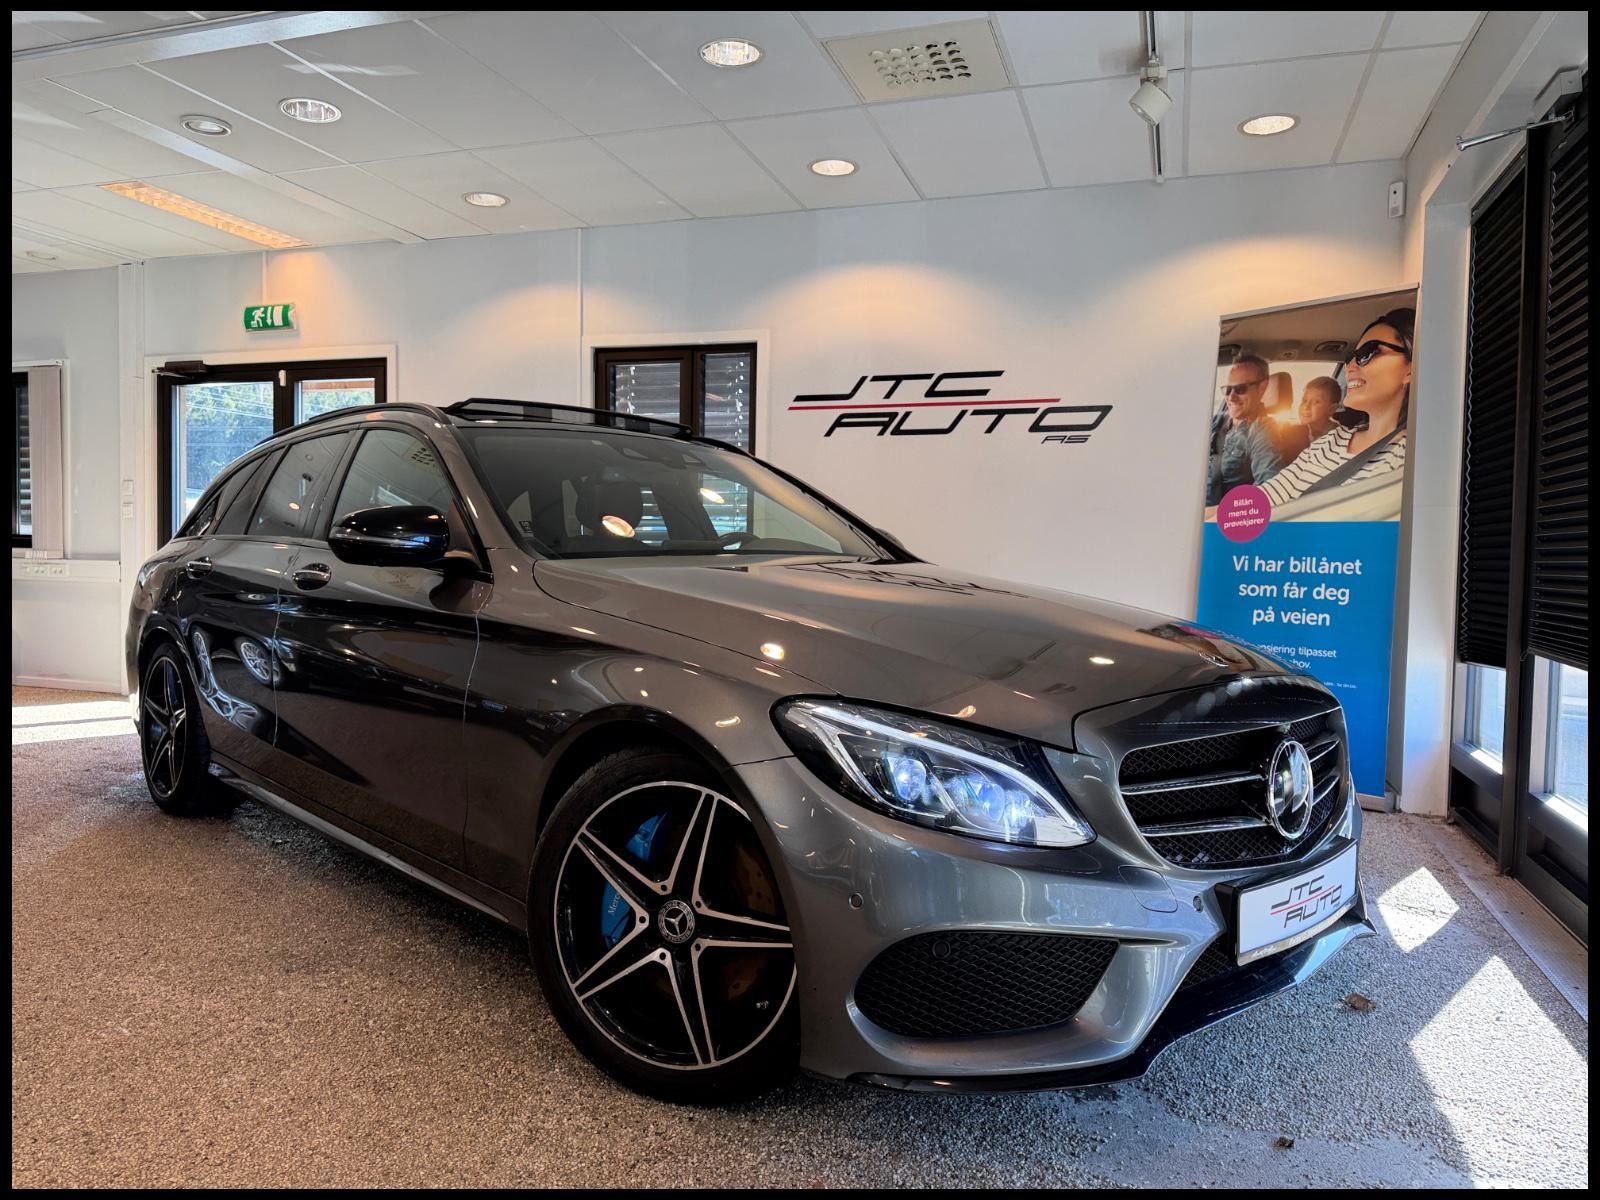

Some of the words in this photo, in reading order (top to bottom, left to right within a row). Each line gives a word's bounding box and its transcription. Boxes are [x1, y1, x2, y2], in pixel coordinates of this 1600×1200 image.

[793, 370, 1005, 402] JTC
[823, 405, 1113, 437] AUTO
[1041, 434, 1091, 444] AS
[1228, 510, 1247, 518] mens
[1249, 507, 1259, 515] du
[1233, 498, 1253, 507] Billån
[1223, 518, 1265, 530] prøvekjører
[1232, 555, 1248, 572] Vi
[1254, 556, 1284, 573] har
[1289, 556, 1362, 575] billånet
[1238, 582, 1277, 598] som
[1283, 581, 1308, 599] får
[1312, 584, 1350, 606] deg
[1252, 606, 1275, 625] på
[1281, 608, 1331, 626] veien
[1298, 646, 1337, 658] tilpasset
[1271, 875, 1324, 910] JTC
[1283, 884, 1342, 928] AUTO
